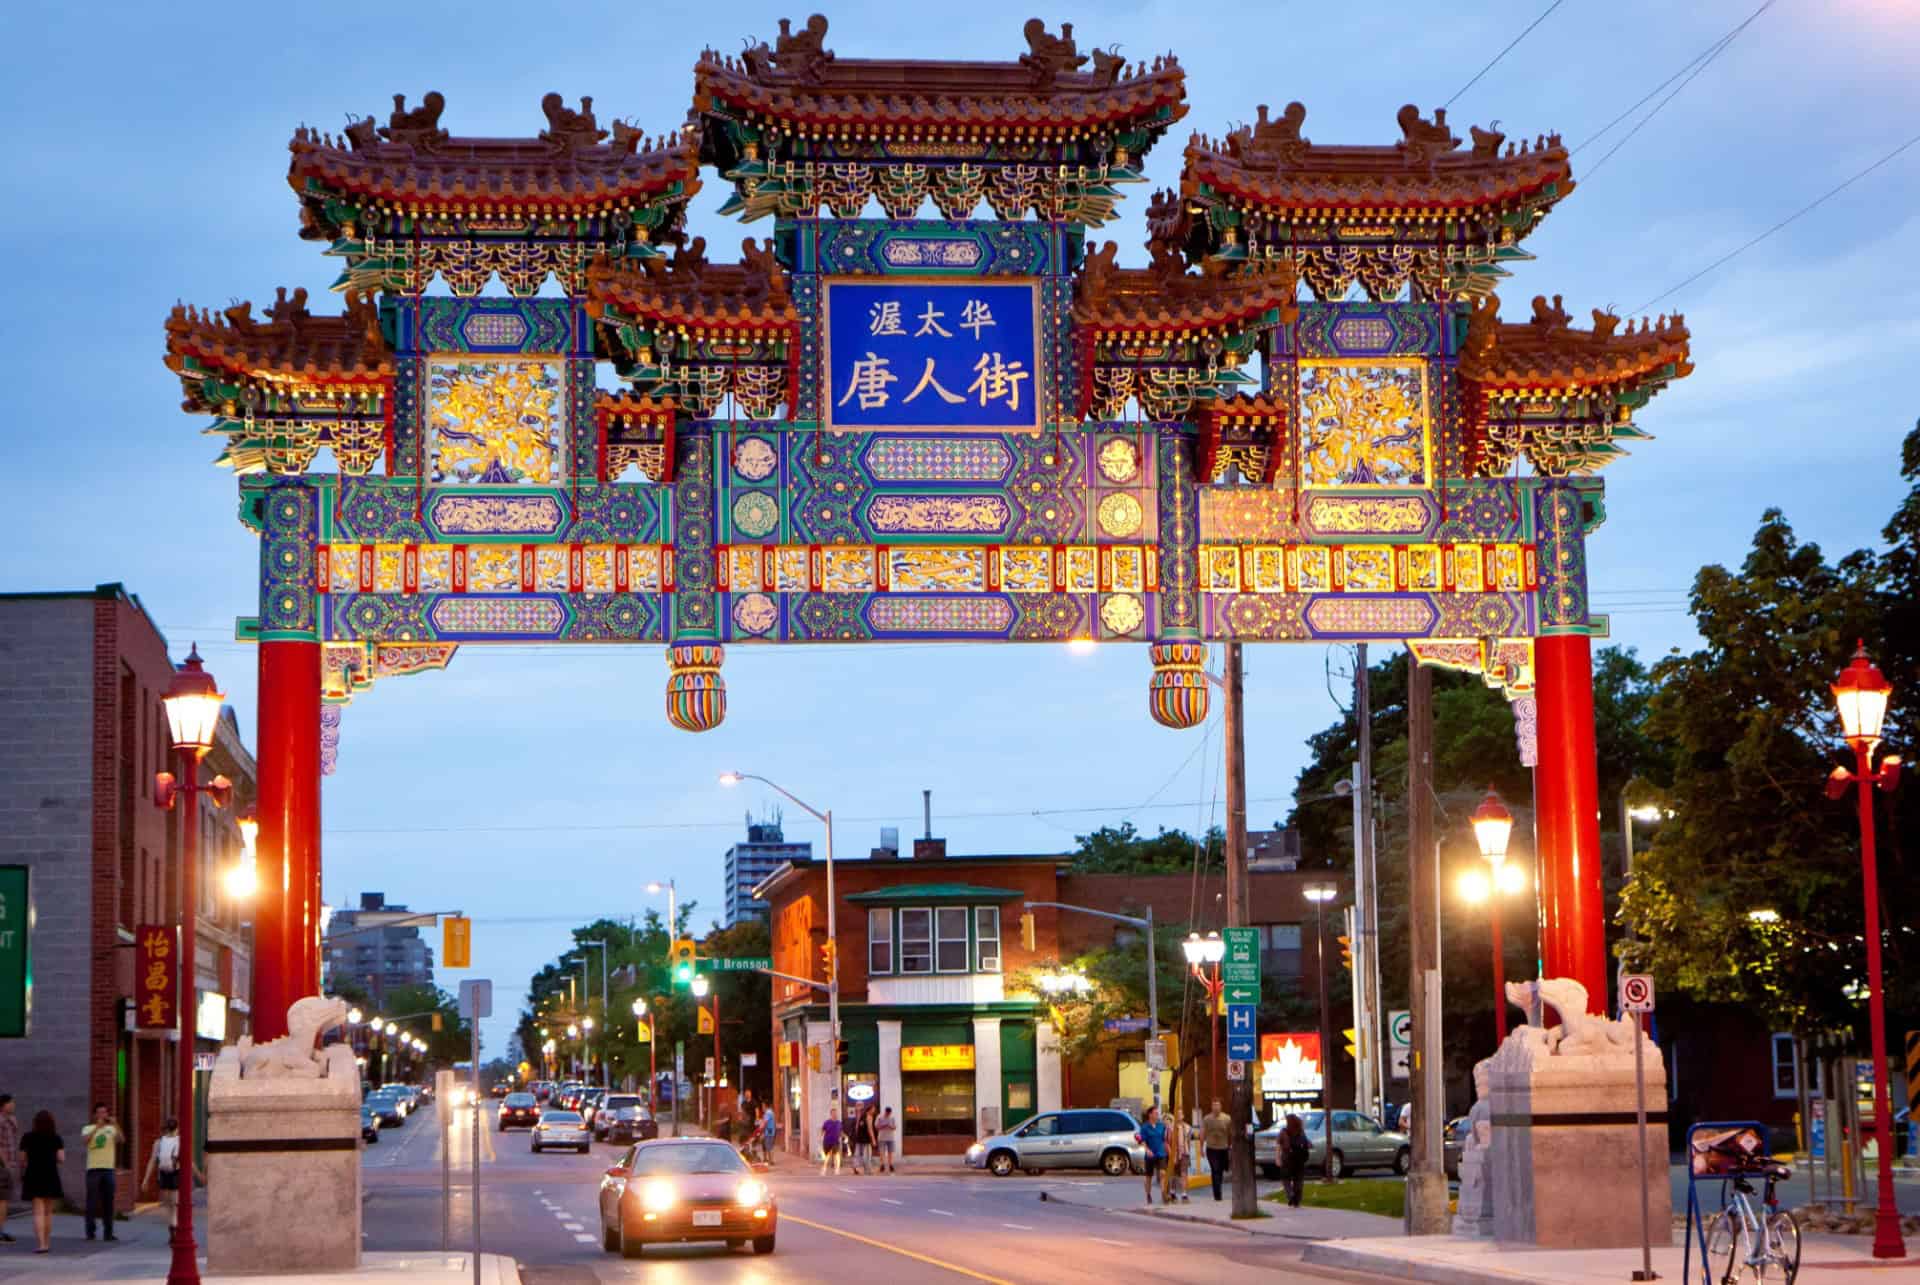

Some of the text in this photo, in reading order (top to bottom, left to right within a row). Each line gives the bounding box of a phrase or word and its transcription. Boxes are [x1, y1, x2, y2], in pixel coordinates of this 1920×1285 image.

[869, 300, 997, 340] 渥太华
[838, 351, 1030, 412] 唐人街
[724, 958, 769, 969] Bronson
[1233, 1010, 1250, 1028] H
